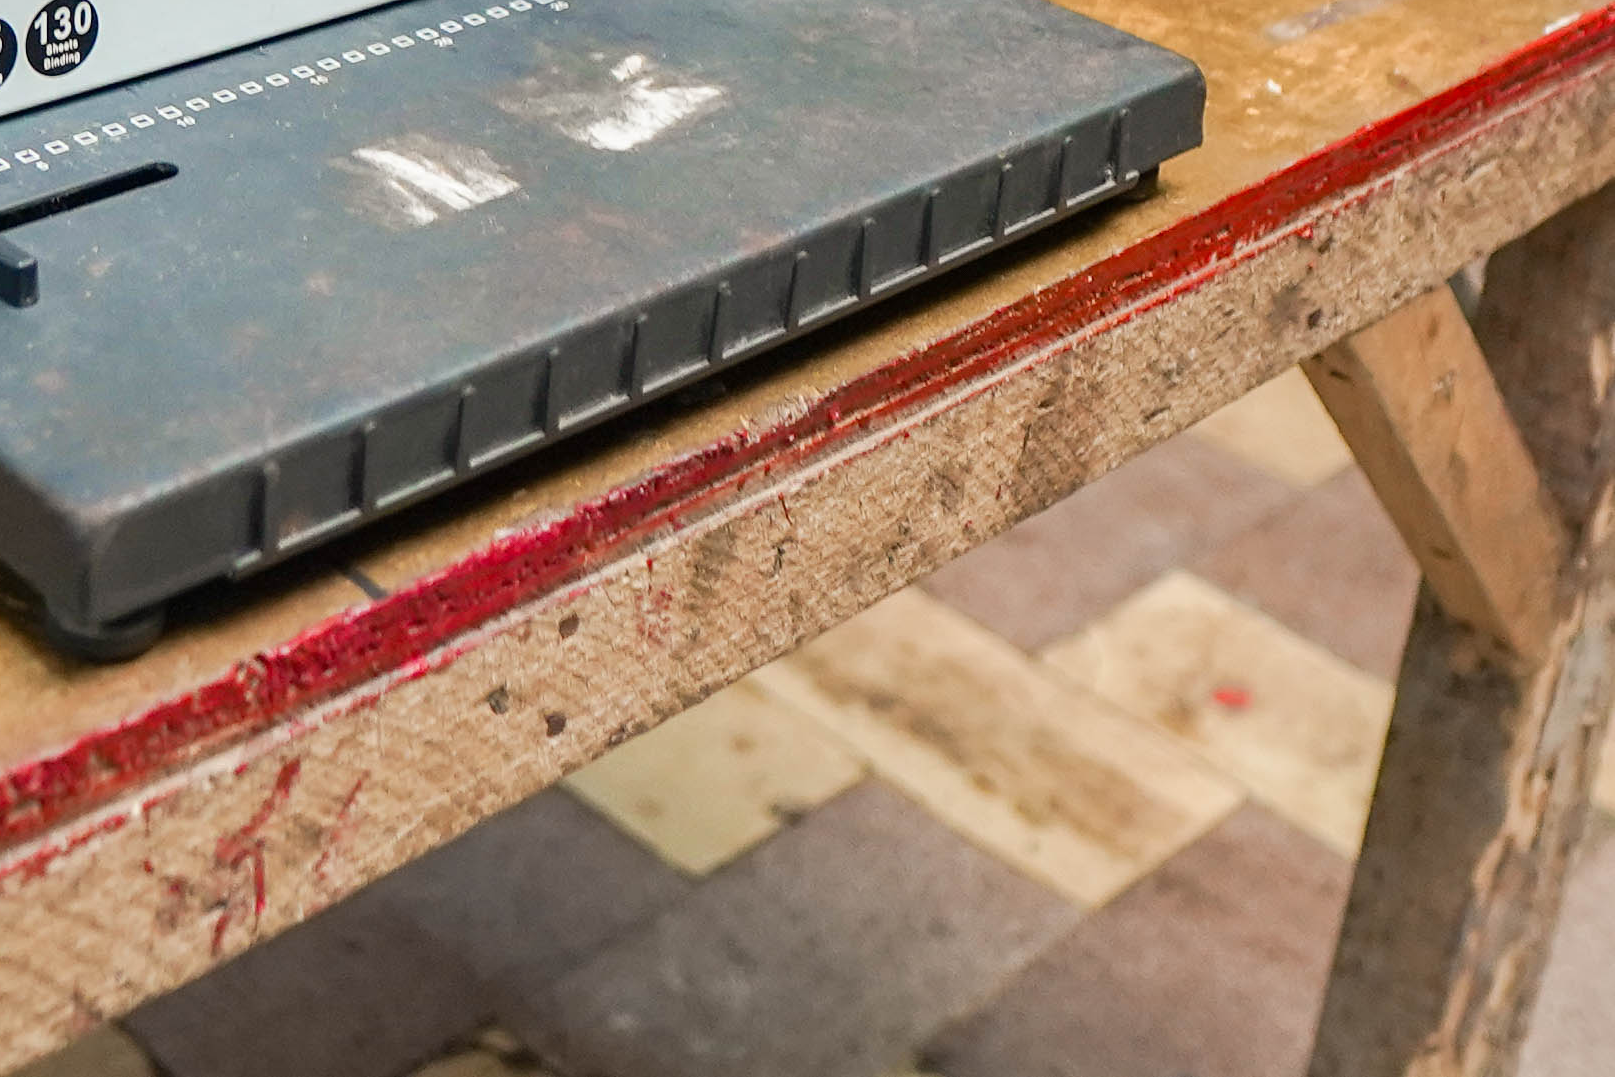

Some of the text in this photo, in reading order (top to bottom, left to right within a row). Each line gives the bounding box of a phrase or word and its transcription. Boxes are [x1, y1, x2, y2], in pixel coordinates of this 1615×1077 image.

[35, 1, 92, 46] 130
[46, 38, 79, 56] Sheets
[176, 115, 196, 128] 10
